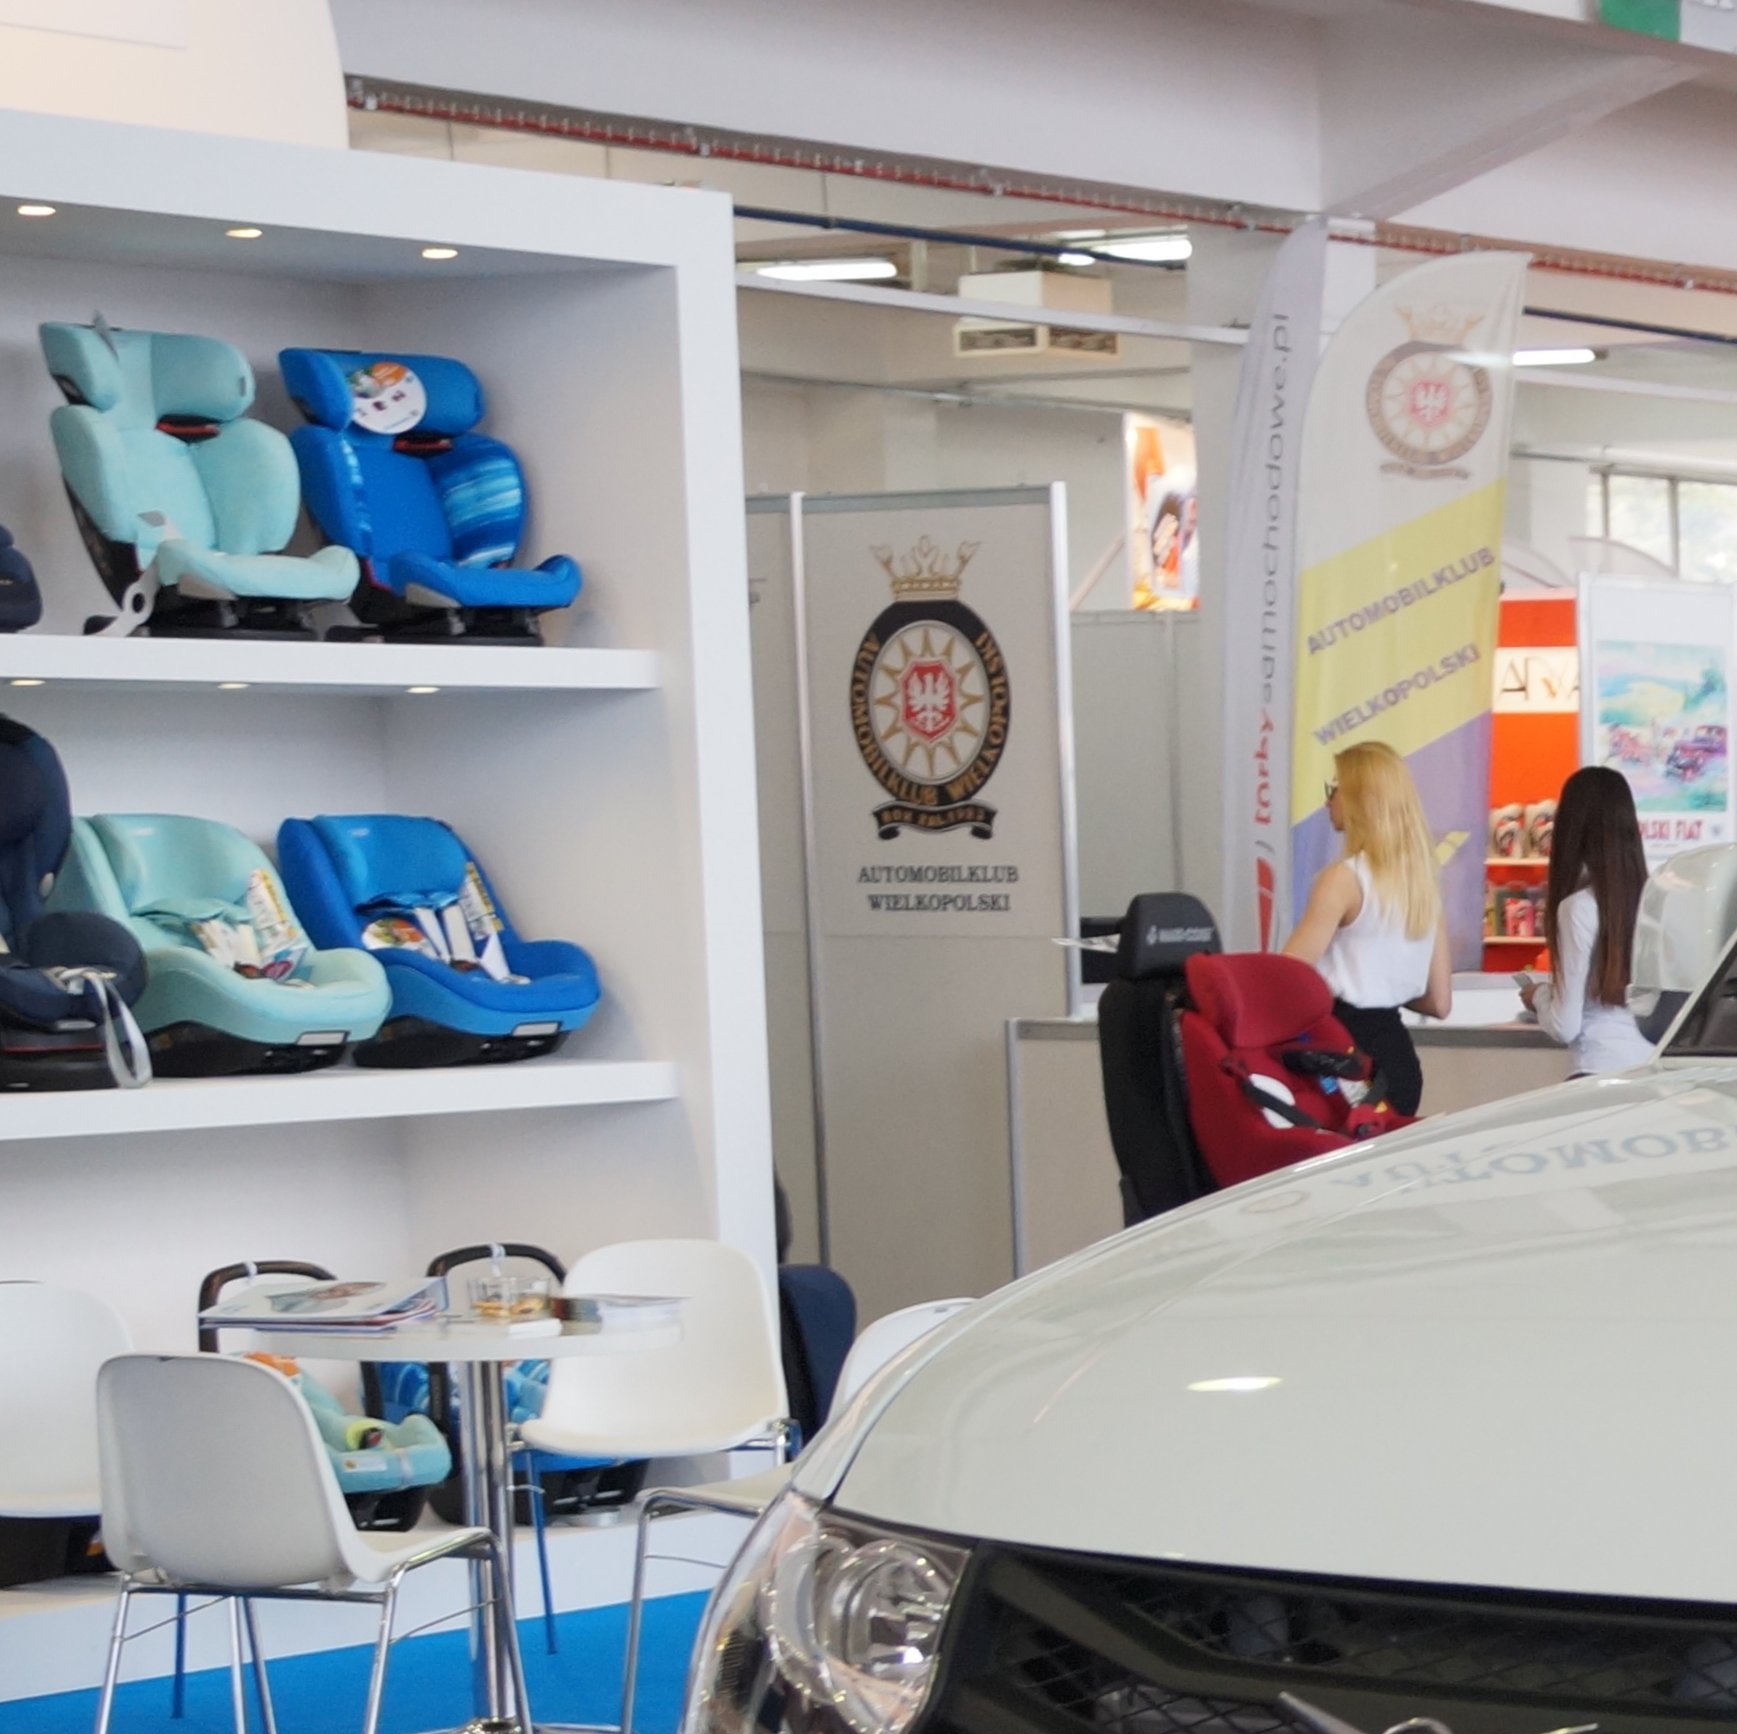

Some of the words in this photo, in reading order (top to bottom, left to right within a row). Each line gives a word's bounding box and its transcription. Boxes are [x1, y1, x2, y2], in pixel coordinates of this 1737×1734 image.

[1306, 546, 1496, 656] AUTOMOBILKLUB
[1313, 643, 1481, 747] WIELKOPOLSKI
[857, 865, 1019, 883] AUTOMOBILKLUB
[867, 893, 1012, 912] WIELKOPOLSKI
